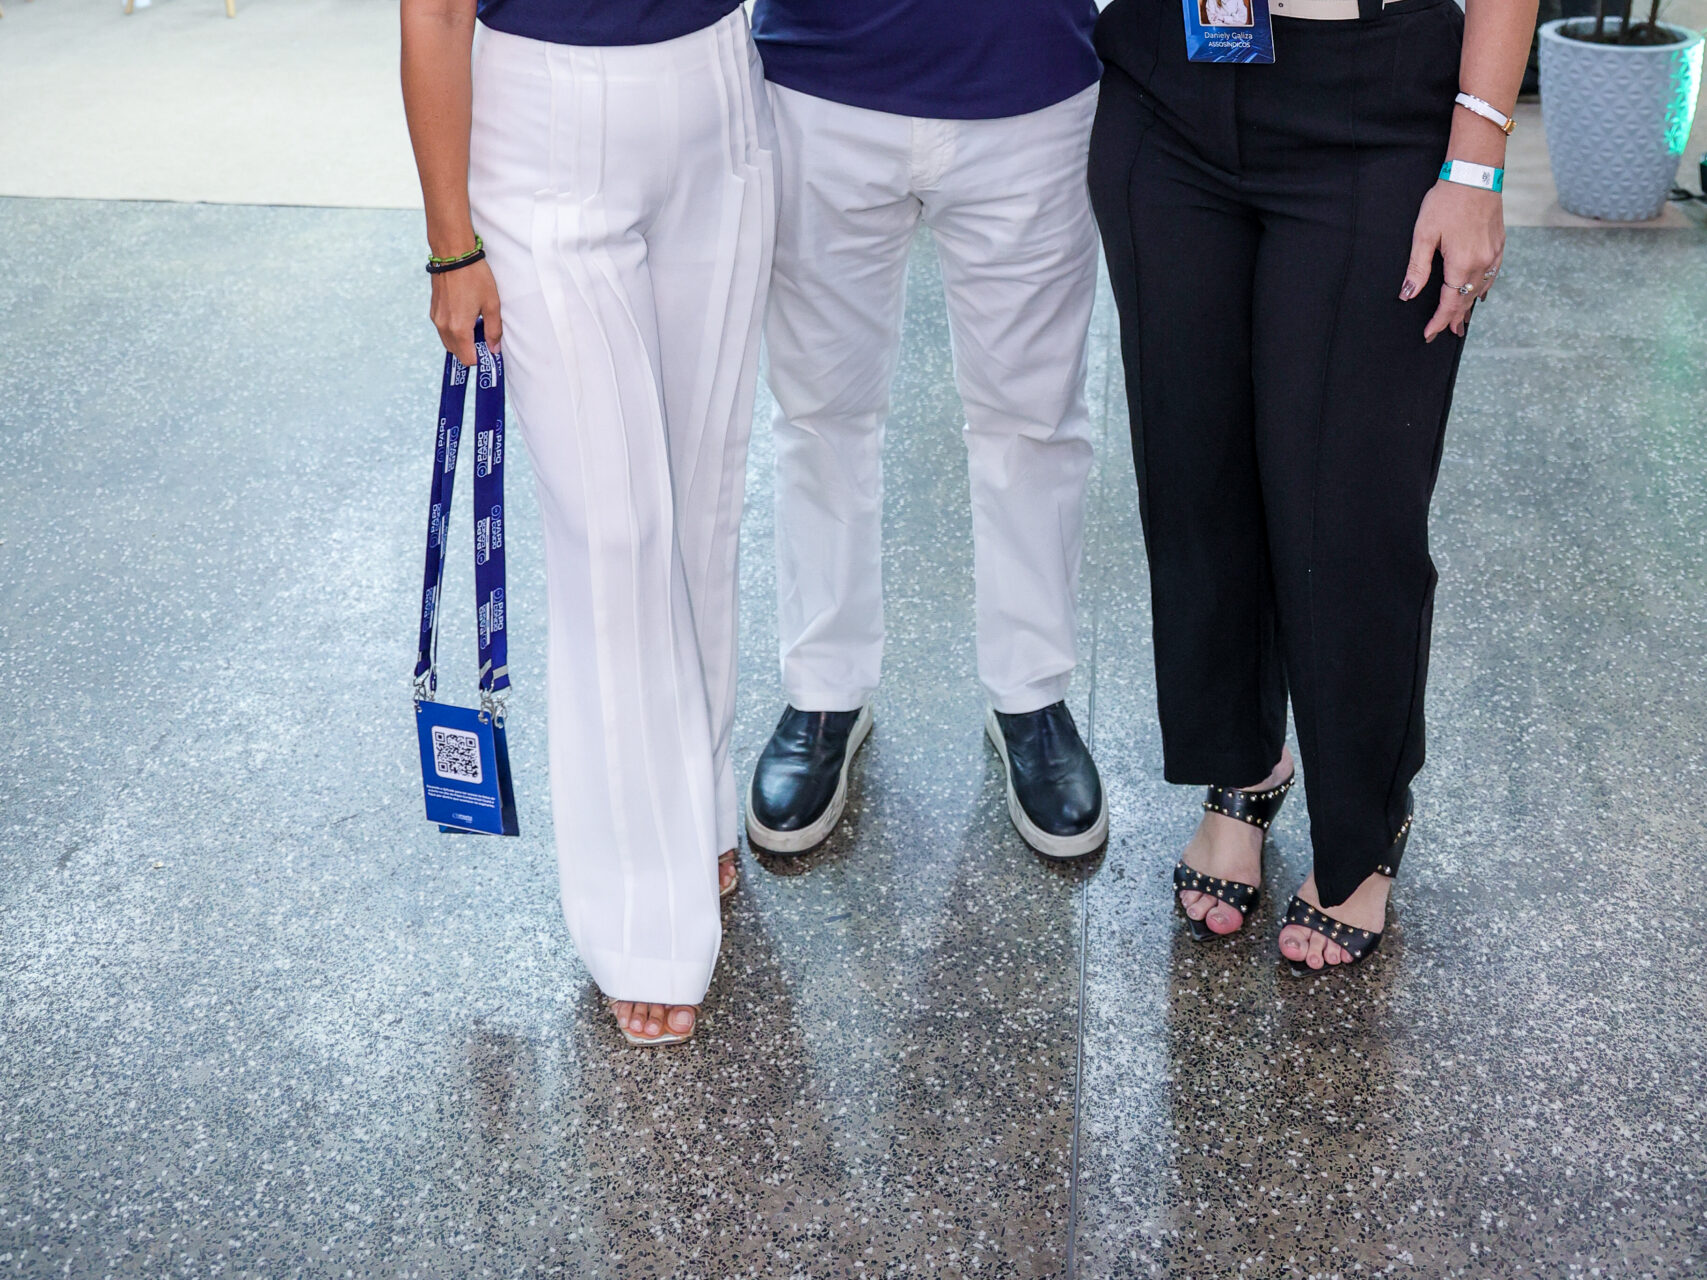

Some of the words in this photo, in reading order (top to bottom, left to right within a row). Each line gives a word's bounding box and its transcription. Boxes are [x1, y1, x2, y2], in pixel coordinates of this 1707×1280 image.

[1204, 31, 1230, 41] Daniely
[1231, 32, 1253, 40] Galiza
[475, 342, 486, 372] PAPO
[438, 417, 447, 447] PAPO
